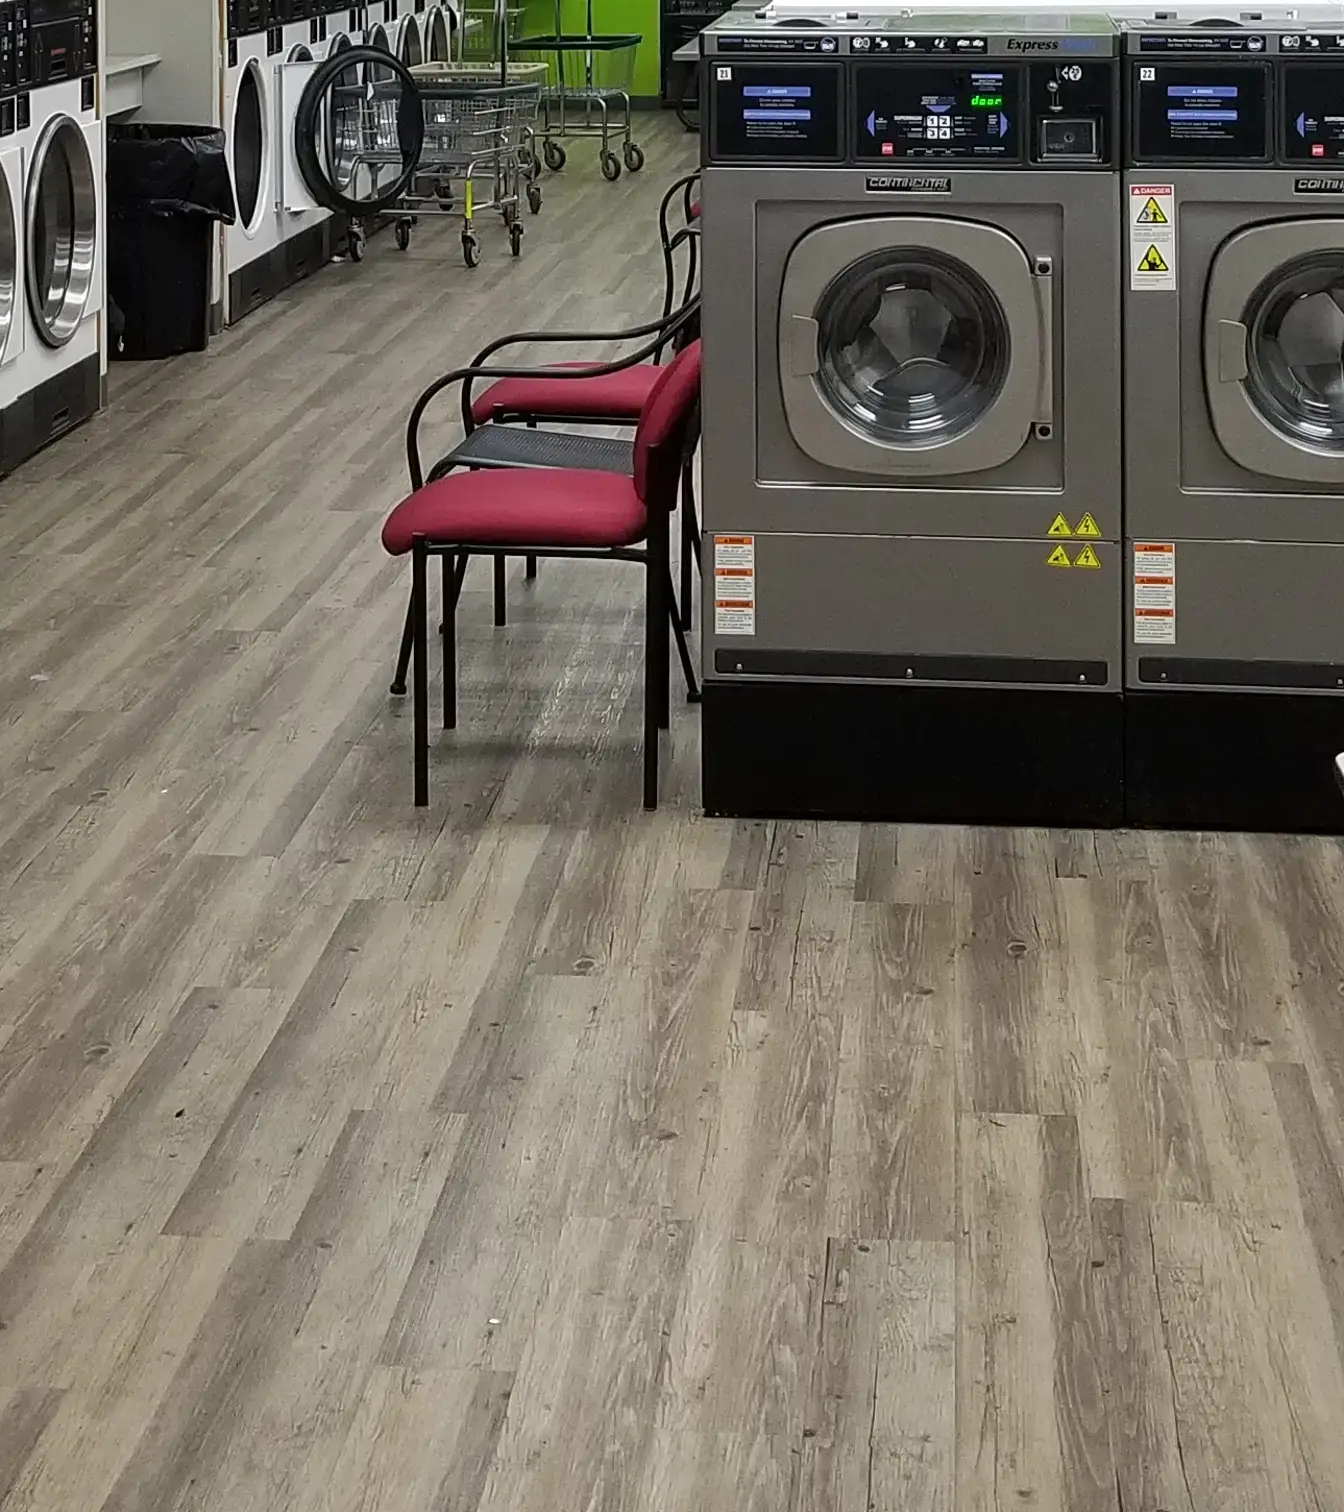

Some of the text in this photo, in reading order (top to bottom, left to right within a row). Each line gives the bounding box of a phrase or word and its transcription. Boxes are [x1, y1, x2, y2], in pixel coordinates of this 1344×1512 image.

[1007, 38, 1059, 52] Express
[720, 70, 728, 78] 21
[1143, 70, 1151, 78] 22
[972, 95, 1001, 105] door
